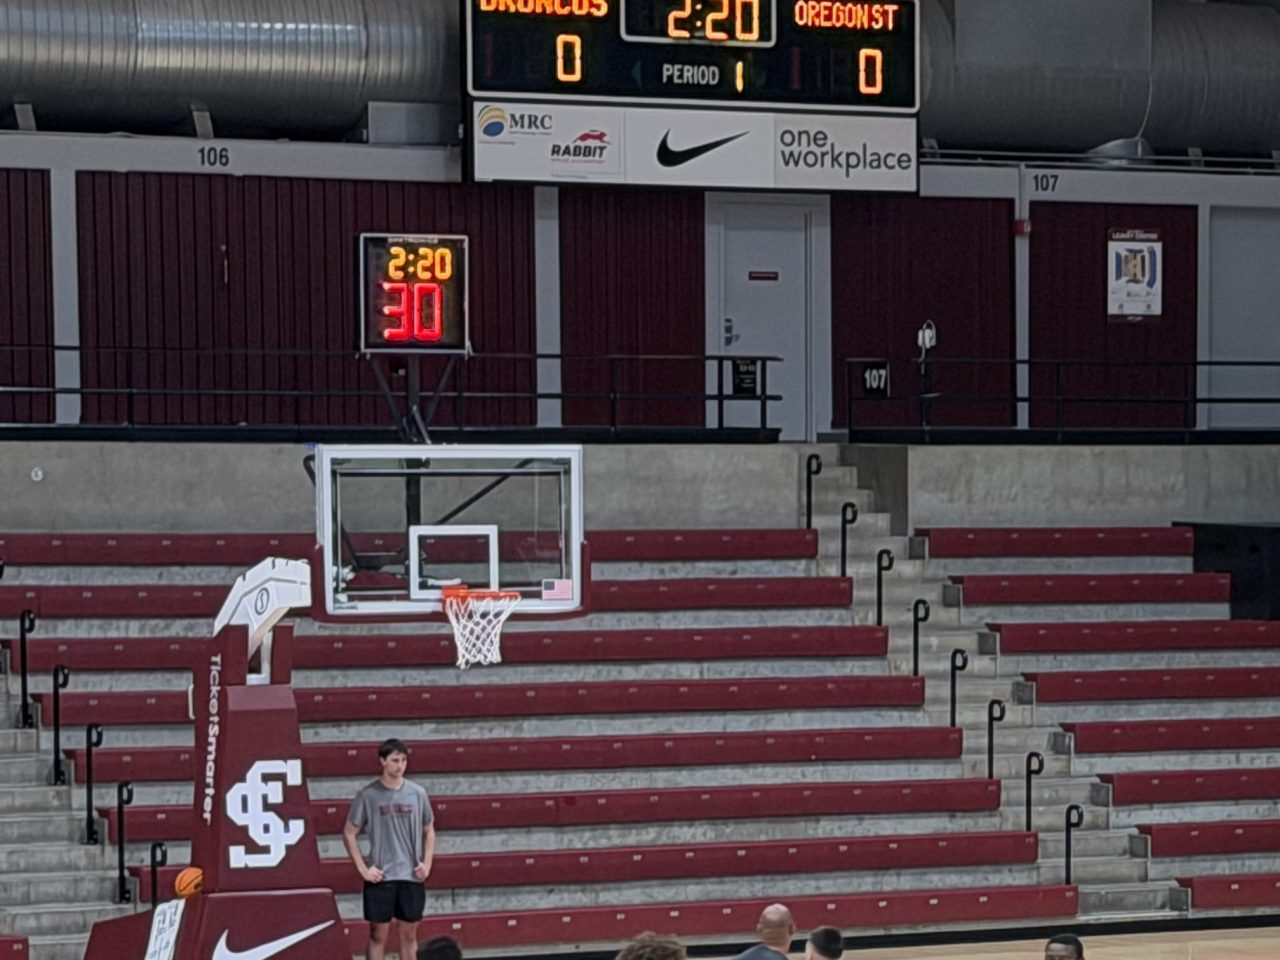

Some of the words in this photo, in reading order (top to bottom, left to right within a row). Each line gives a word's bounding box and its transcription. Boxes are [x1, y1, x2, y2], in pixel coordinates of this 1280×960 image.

[667, 0, 759, 40] 2:20
[556, 34, 581, 81] 0
[859, 48, 882, 94] 0
[662, 63, 719, 85] PERIOD
[735, 61, 744, 92] 1
[509, 113, 552, 130] MRC
[551, 144, 607, 158] RABBIT
[780, 129, 828, 148] one
[198, 146, 229, 167] 106
[781, 142, 912, 178] workplace
[1033, 174, 1059, 192] 107
[388, 246, 452, 280] 2:20
[383, 283, 442, 341] 30
[864, 368, 888, 389] 107
